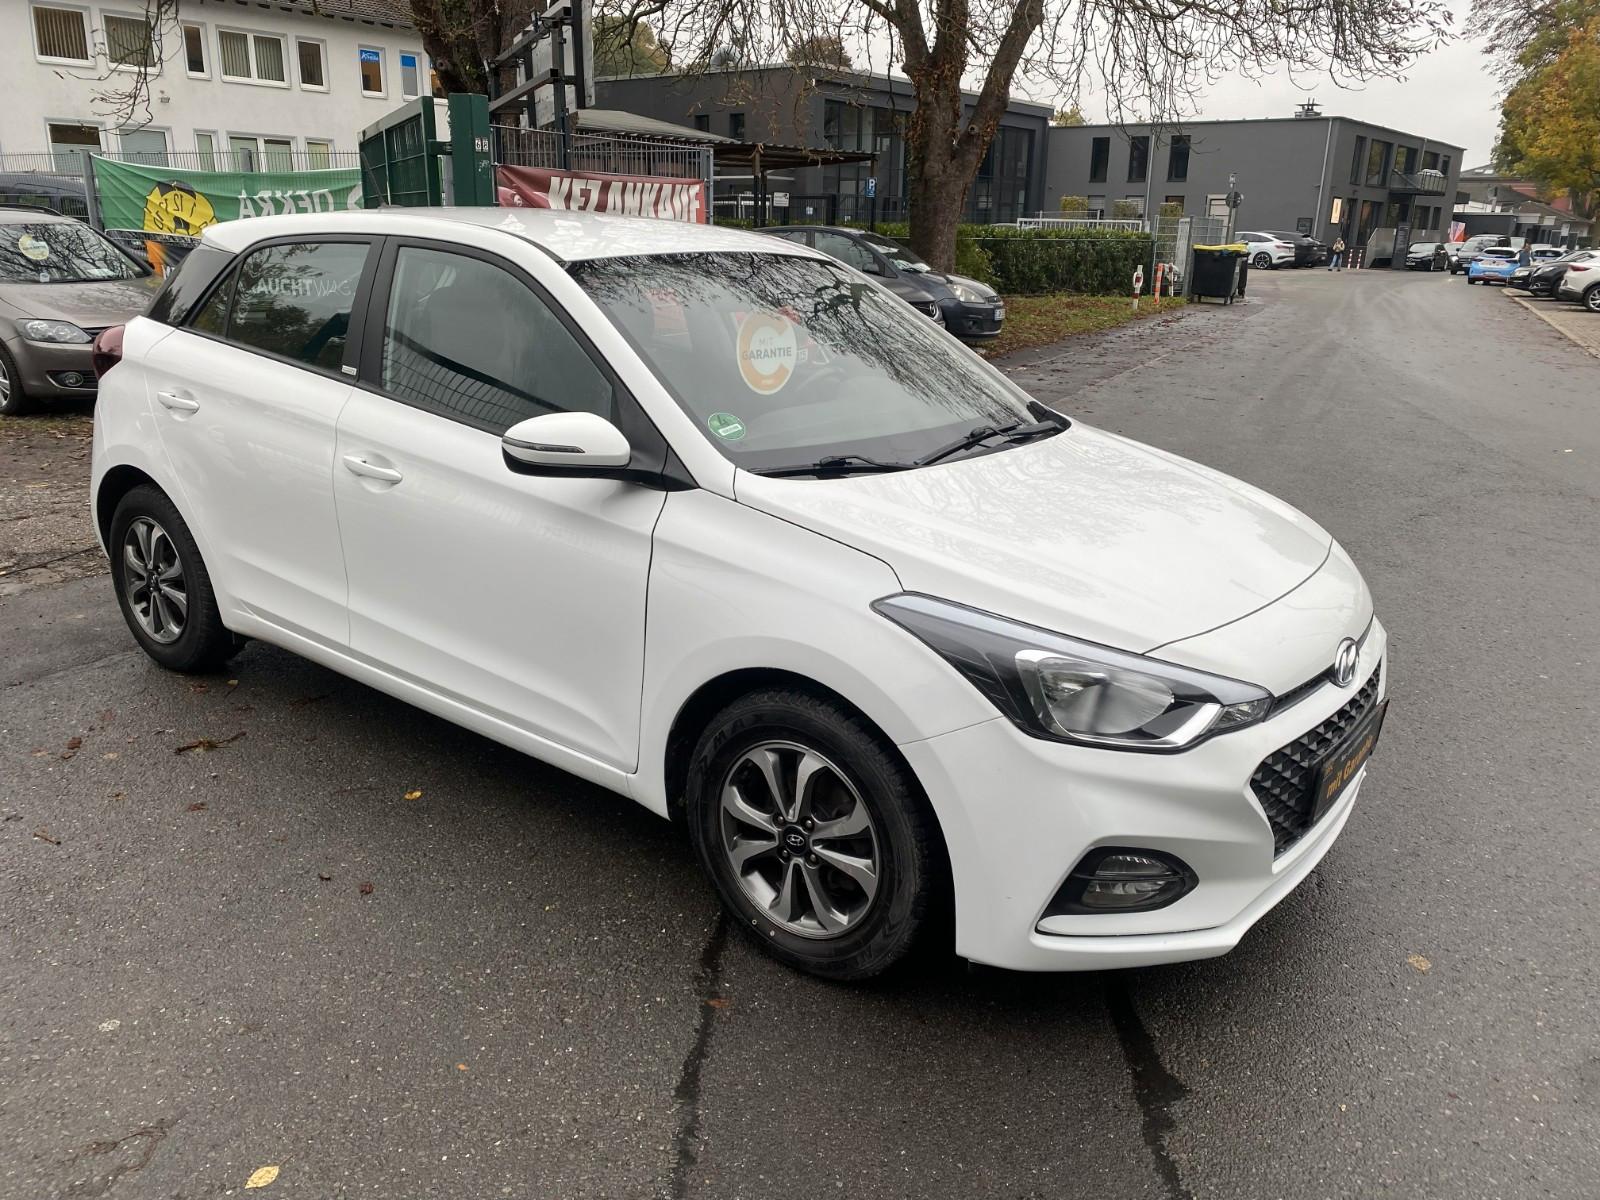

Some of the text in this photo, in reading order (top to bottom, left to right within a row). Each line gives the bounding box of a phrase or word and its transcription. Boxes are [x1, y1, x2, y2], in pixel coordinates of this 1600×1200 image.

[869, 178, 876, 190] P
[605, 181, 700, 223] ANKAUF
[742, 346, 792, 361] GARANTIE
